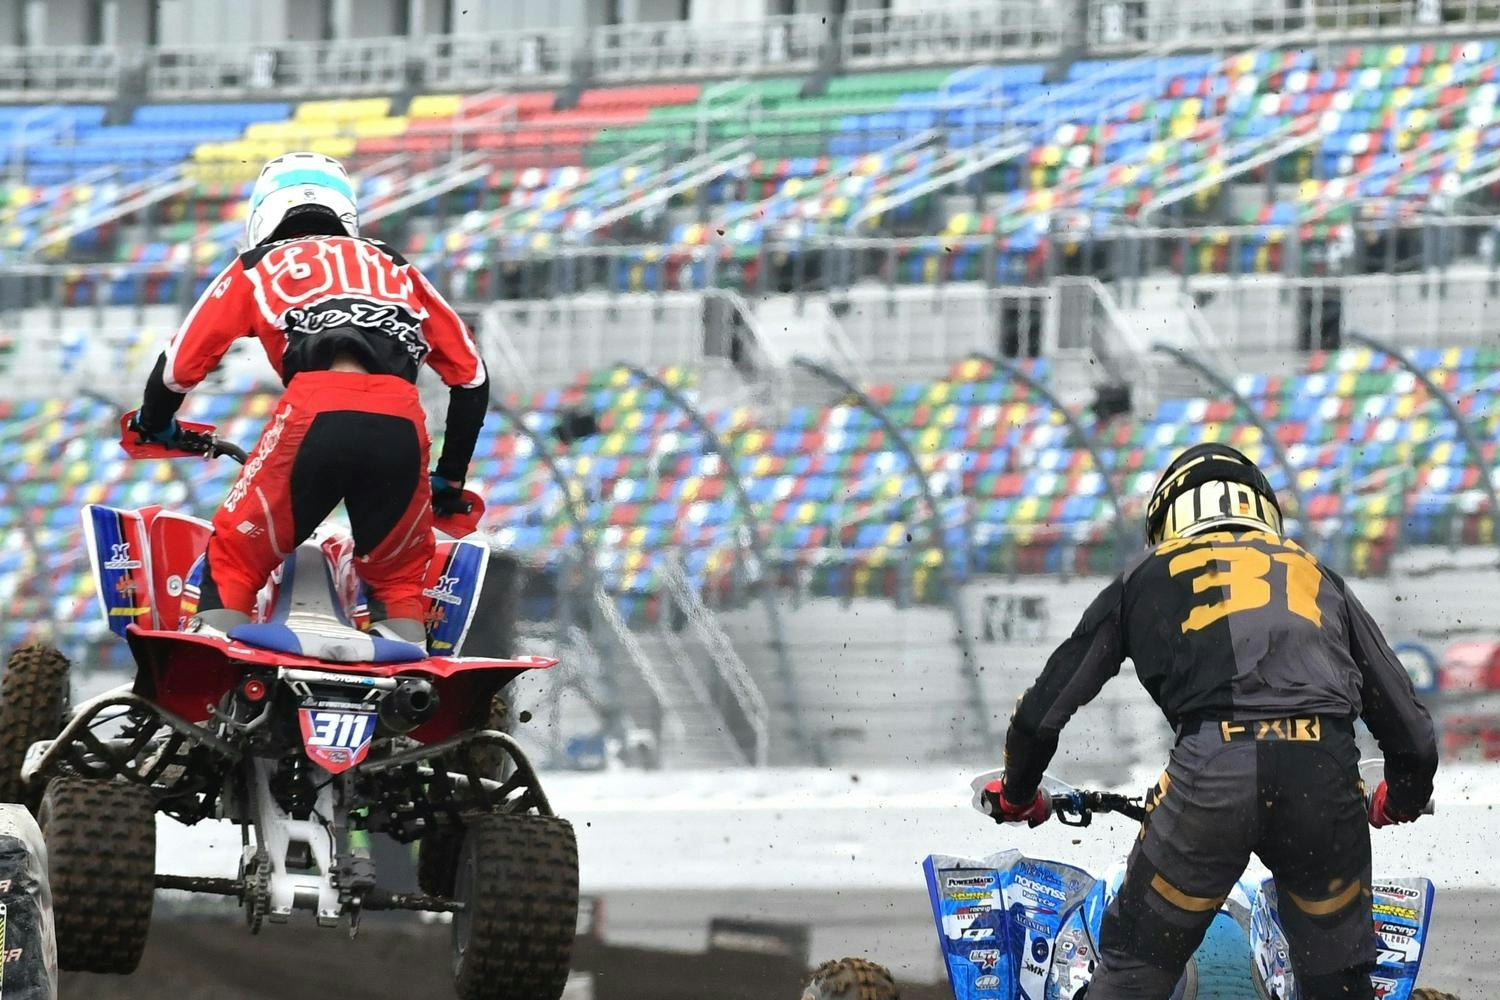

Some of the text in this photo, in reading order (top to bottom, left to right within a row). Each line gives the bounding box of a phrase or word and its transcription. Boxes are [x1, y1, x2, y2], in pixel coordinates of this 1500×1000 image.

[1168, 546, 1322, 634] 31
[307, 713, 369, 748] 311
[1381, 924, 1417, 937] racing
